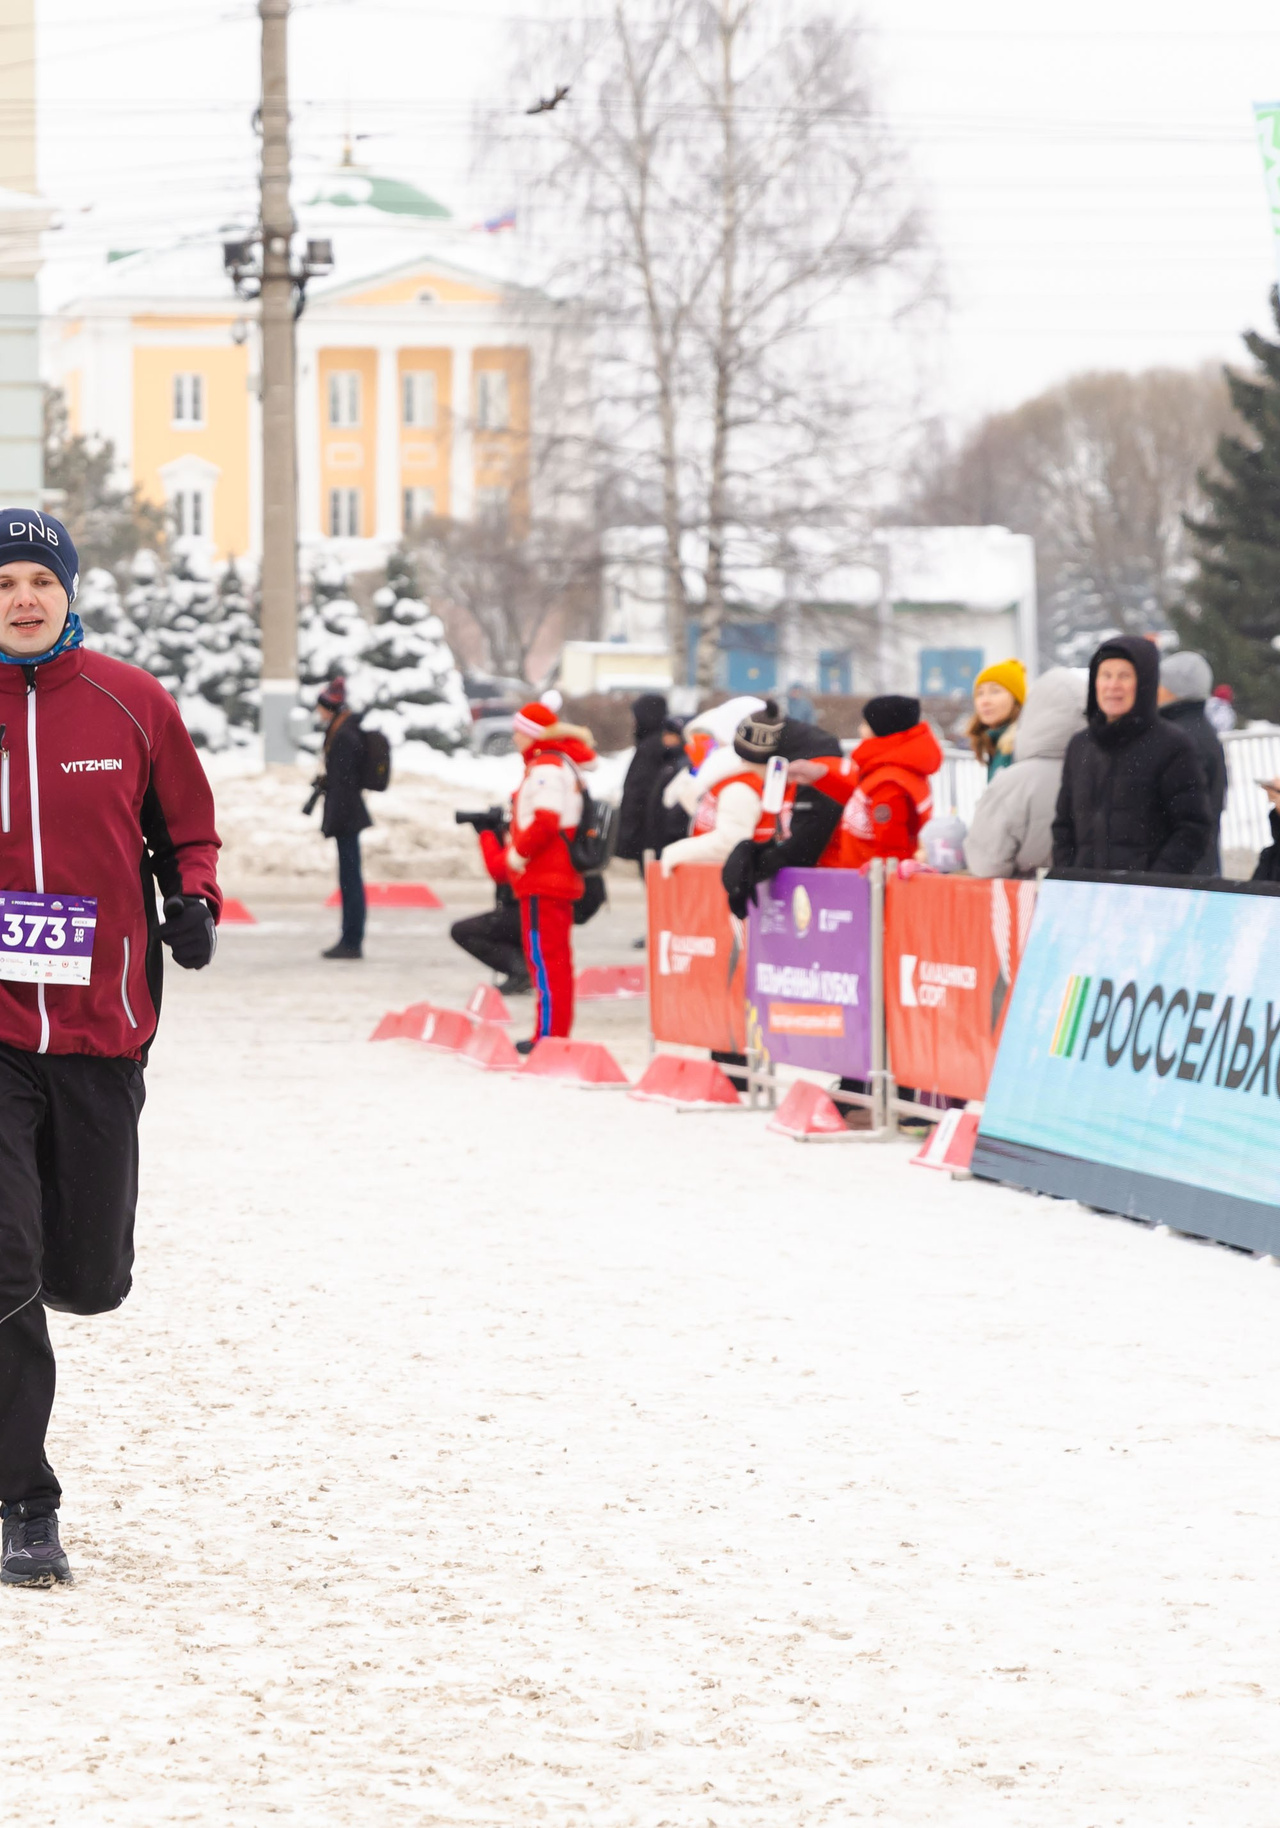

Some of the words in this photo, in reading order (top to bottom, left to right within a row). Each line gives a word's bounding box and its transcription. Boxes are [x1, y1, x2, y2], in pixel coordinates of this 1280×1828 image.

[9, 516, 59, 546] DNB
[60, 758, 122, 774] VITZHEN
[1, 913, 67, 950] 373
